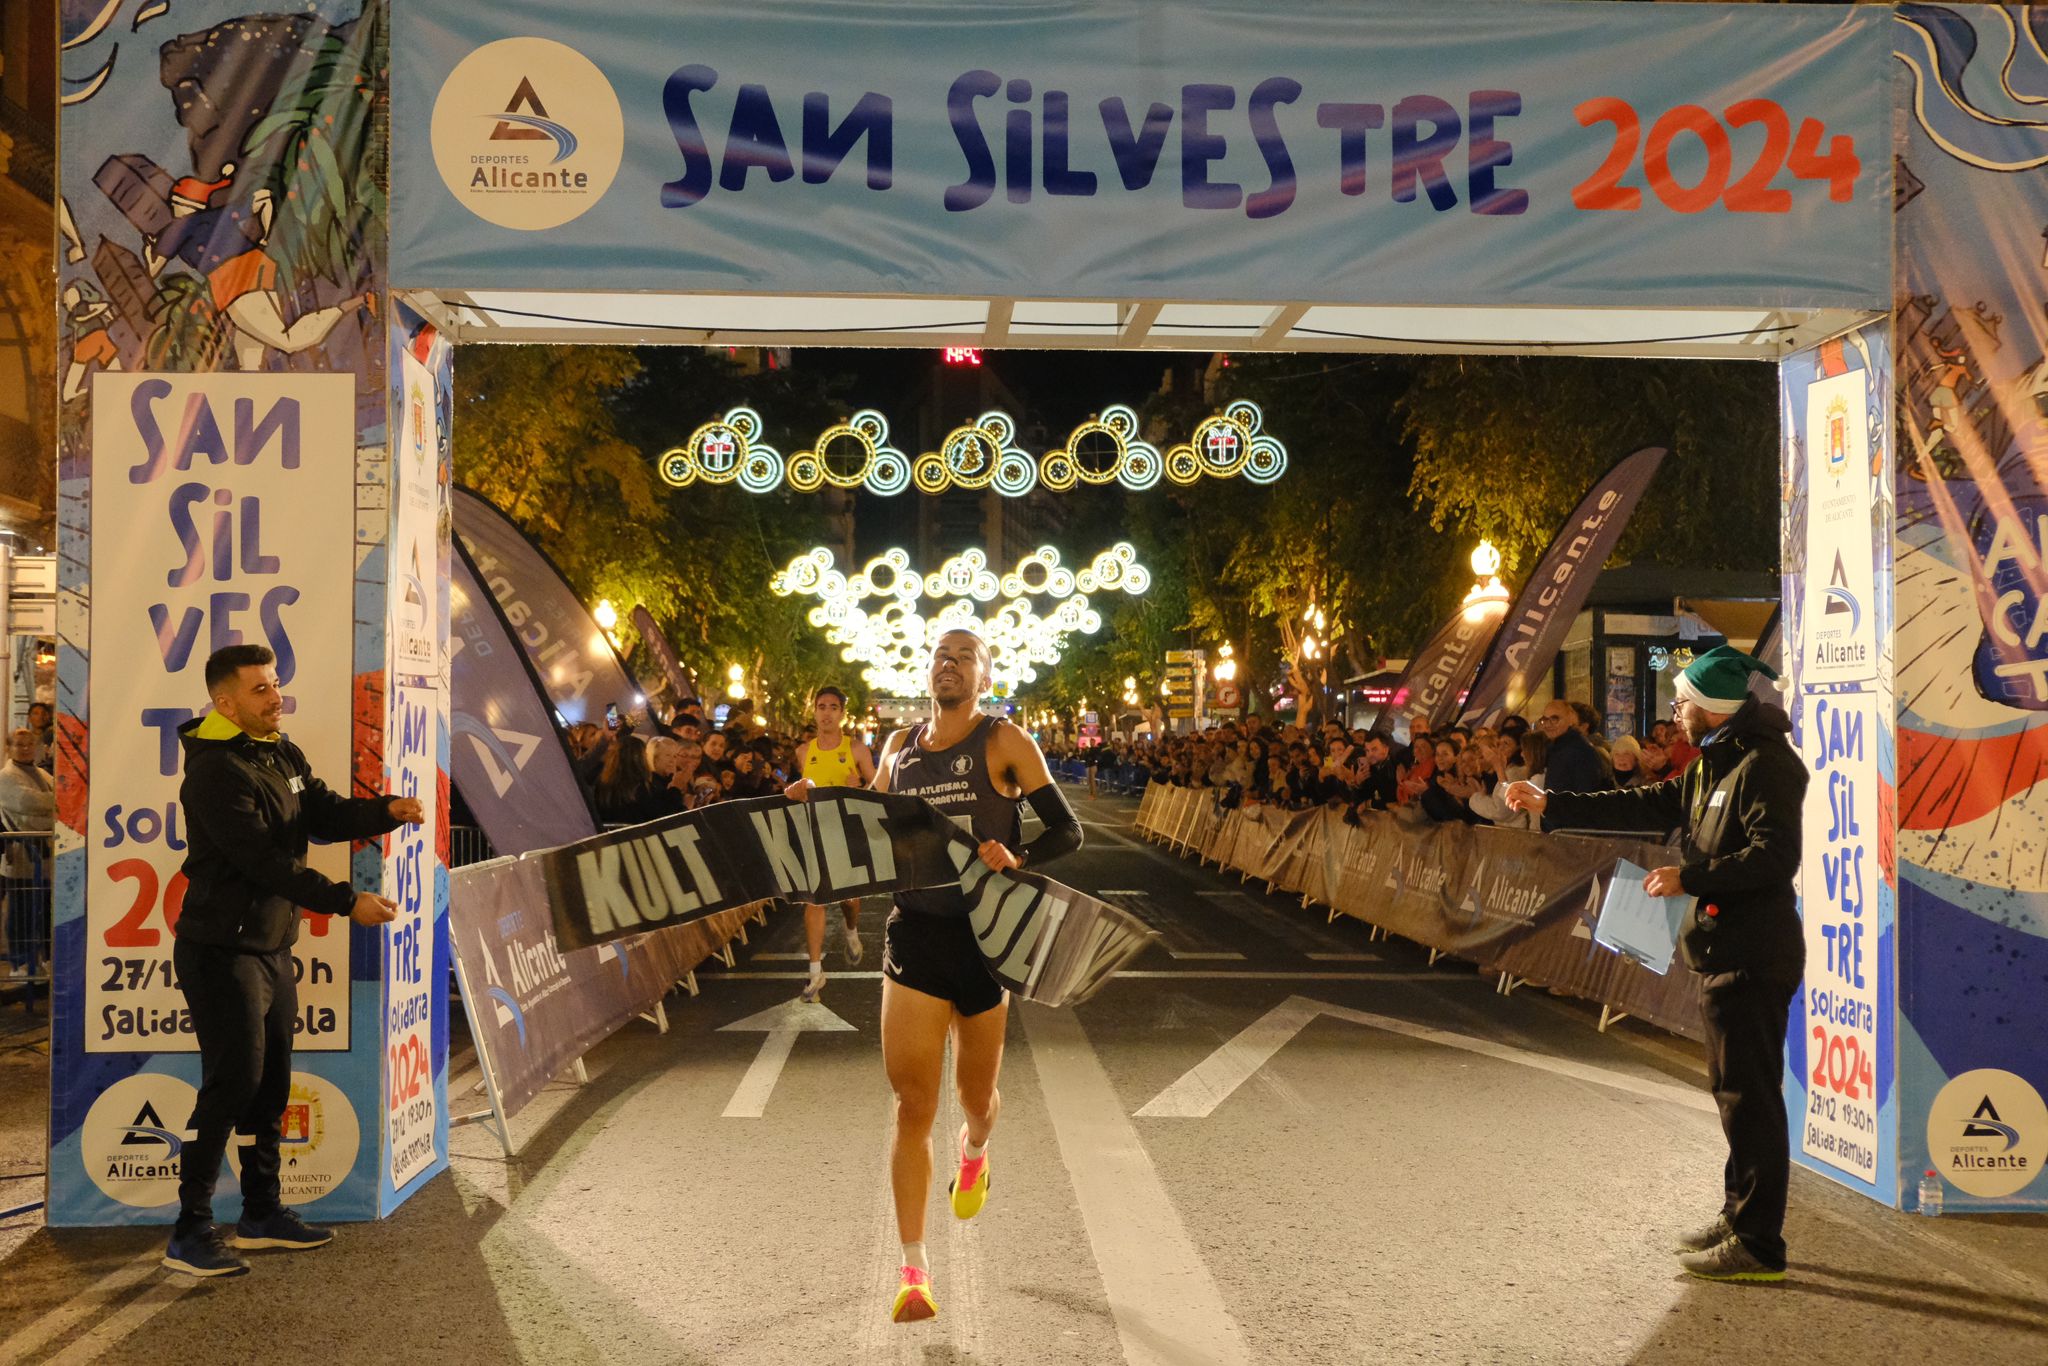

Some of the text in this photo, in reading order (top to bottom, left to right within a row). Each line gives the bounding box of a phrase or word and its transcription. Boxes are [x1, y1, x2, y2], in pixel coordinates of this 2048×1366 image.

[470, 155, 529, 164] DEPORTES
[660, 63, 893, 209] SAN
[1571, 96, 1861, 213] 2024
[470, 166, 588, 188] Alicante
[128, 378, 301, 484] SAN
[1505, 489, 1619, 671] Alicante
[1815, 641, 1866, 664] Alicante
[1815, 698, 1864, 771] SAN
[920, 780, 969, 796] ATLETISMO
[396, 839, 424, 915] VES
[576, 823, 723, 936] KULT
[749, 797, 897, 895] KULT
[1486, 874, 1546, 917] Alicante
[1822, 844, 1864, 919] VES
[394, 917, 422, 985] TRE
[1822, 922, 1865, 990] TRE
[390, 1033, 429, 1112] 2024
[1812, 1025, 1873, 1101] 2024
[1806, 1122, 1873, 1170] Salida: Rambla
[1810, 1089, 1874, 1135] 27/12 19:30 h
[106, 1154, 150, 1162] DEPORTES
[106, 1162, 181, 1178] Alicant
[280, 1173, 332, 1184] TAMIENTO
[1951, 1153, 2028, 1168] Alicante
